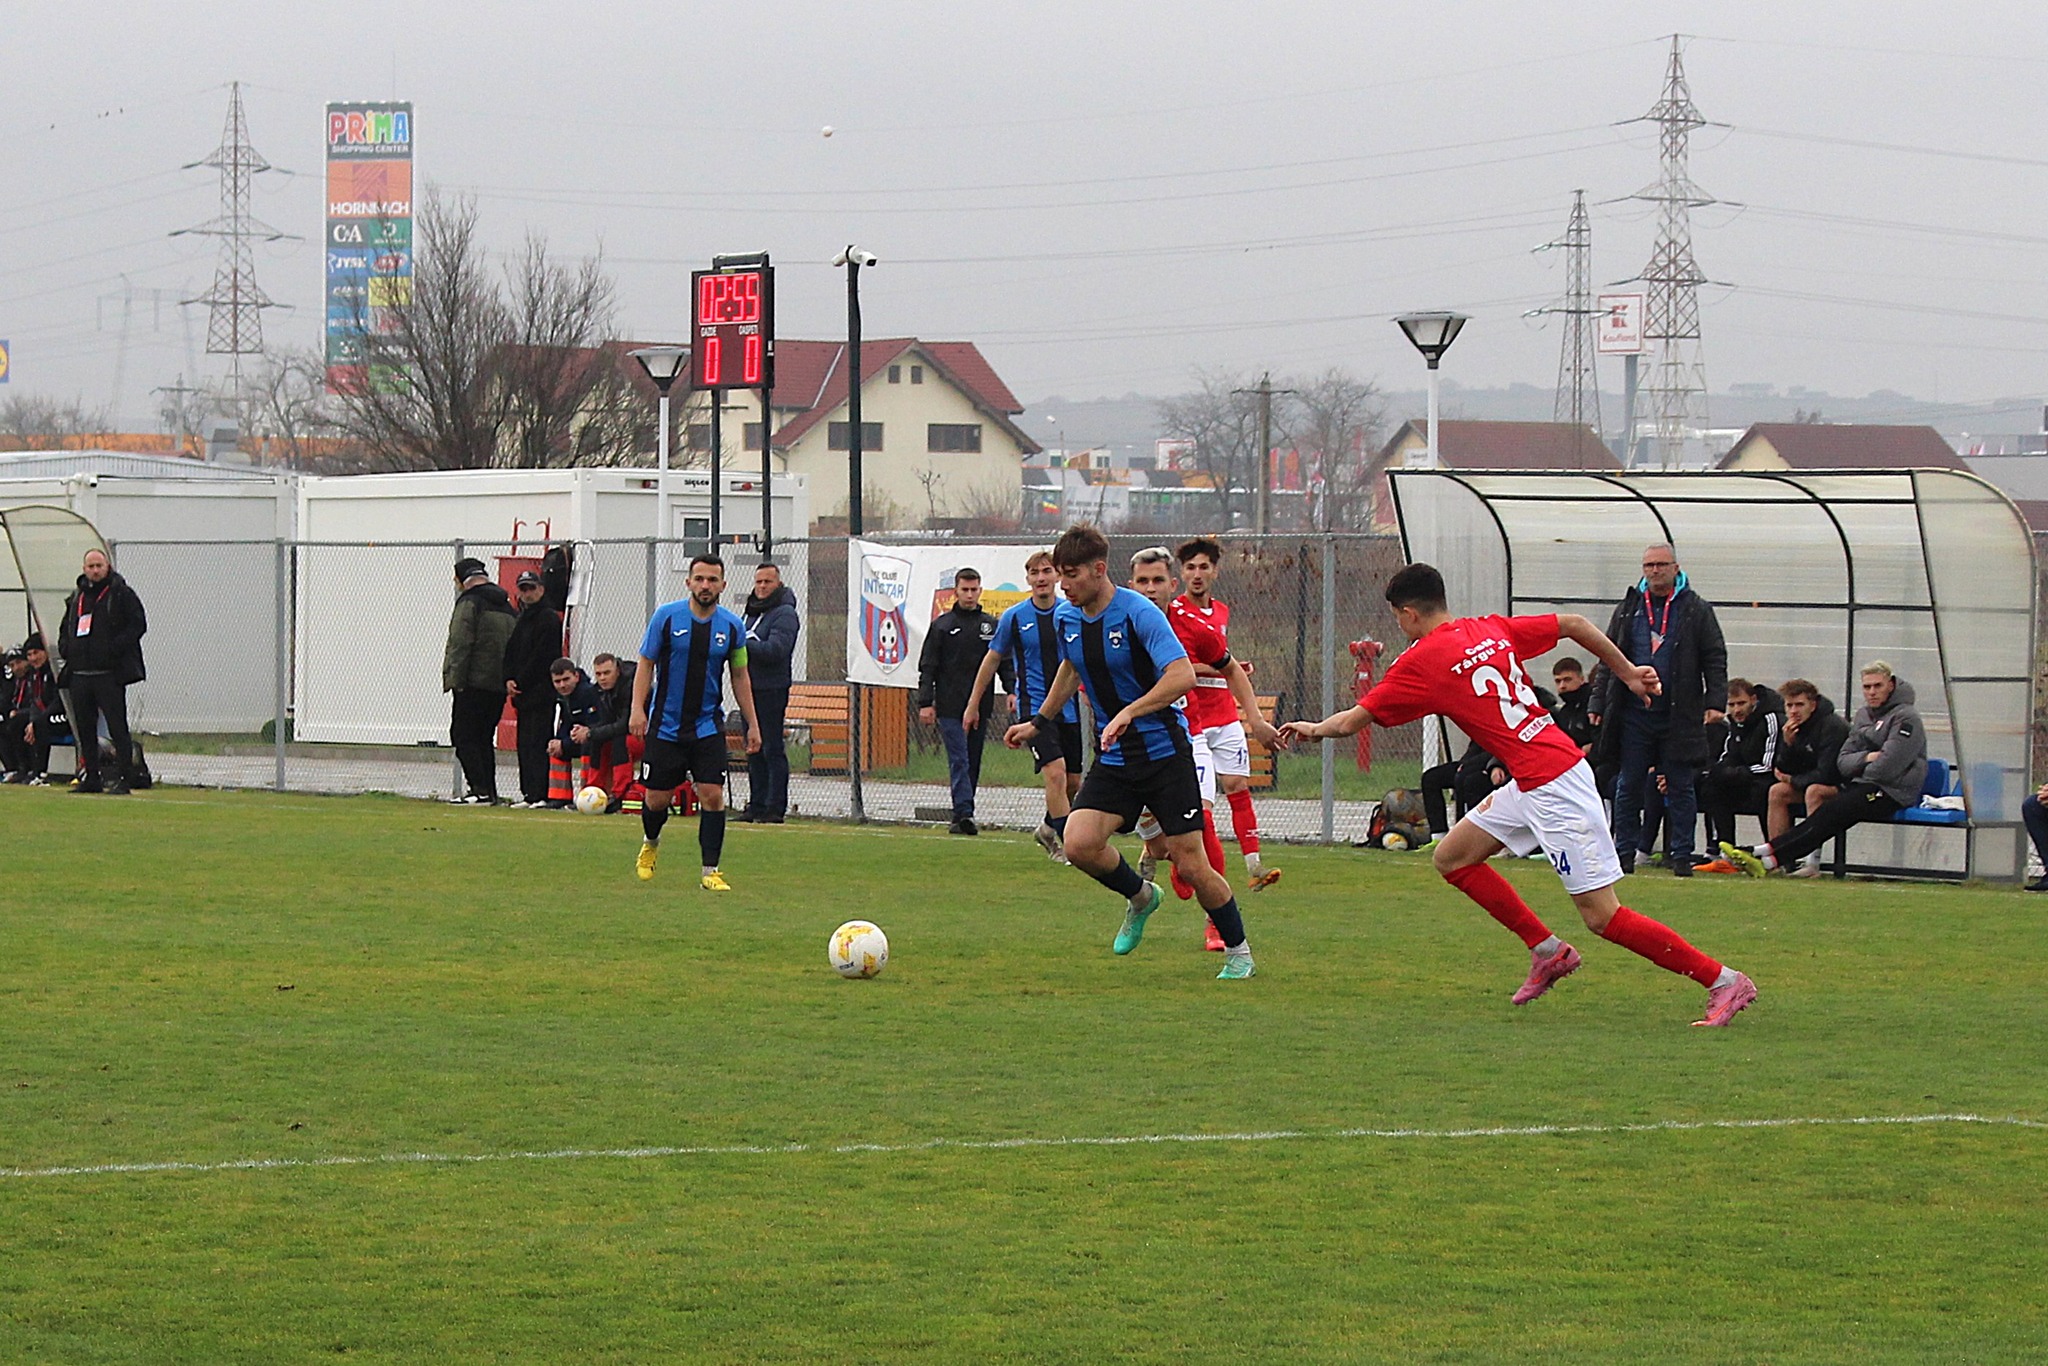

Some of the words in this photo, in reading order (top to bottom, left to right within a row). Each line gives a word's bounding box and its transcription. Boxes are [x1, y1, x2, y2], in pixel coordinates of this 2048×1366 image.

[375, 144, 409, 153] CENTER
[1471, 651, 1540, 730] 24
[1550, 851, 1571, 876] 24
